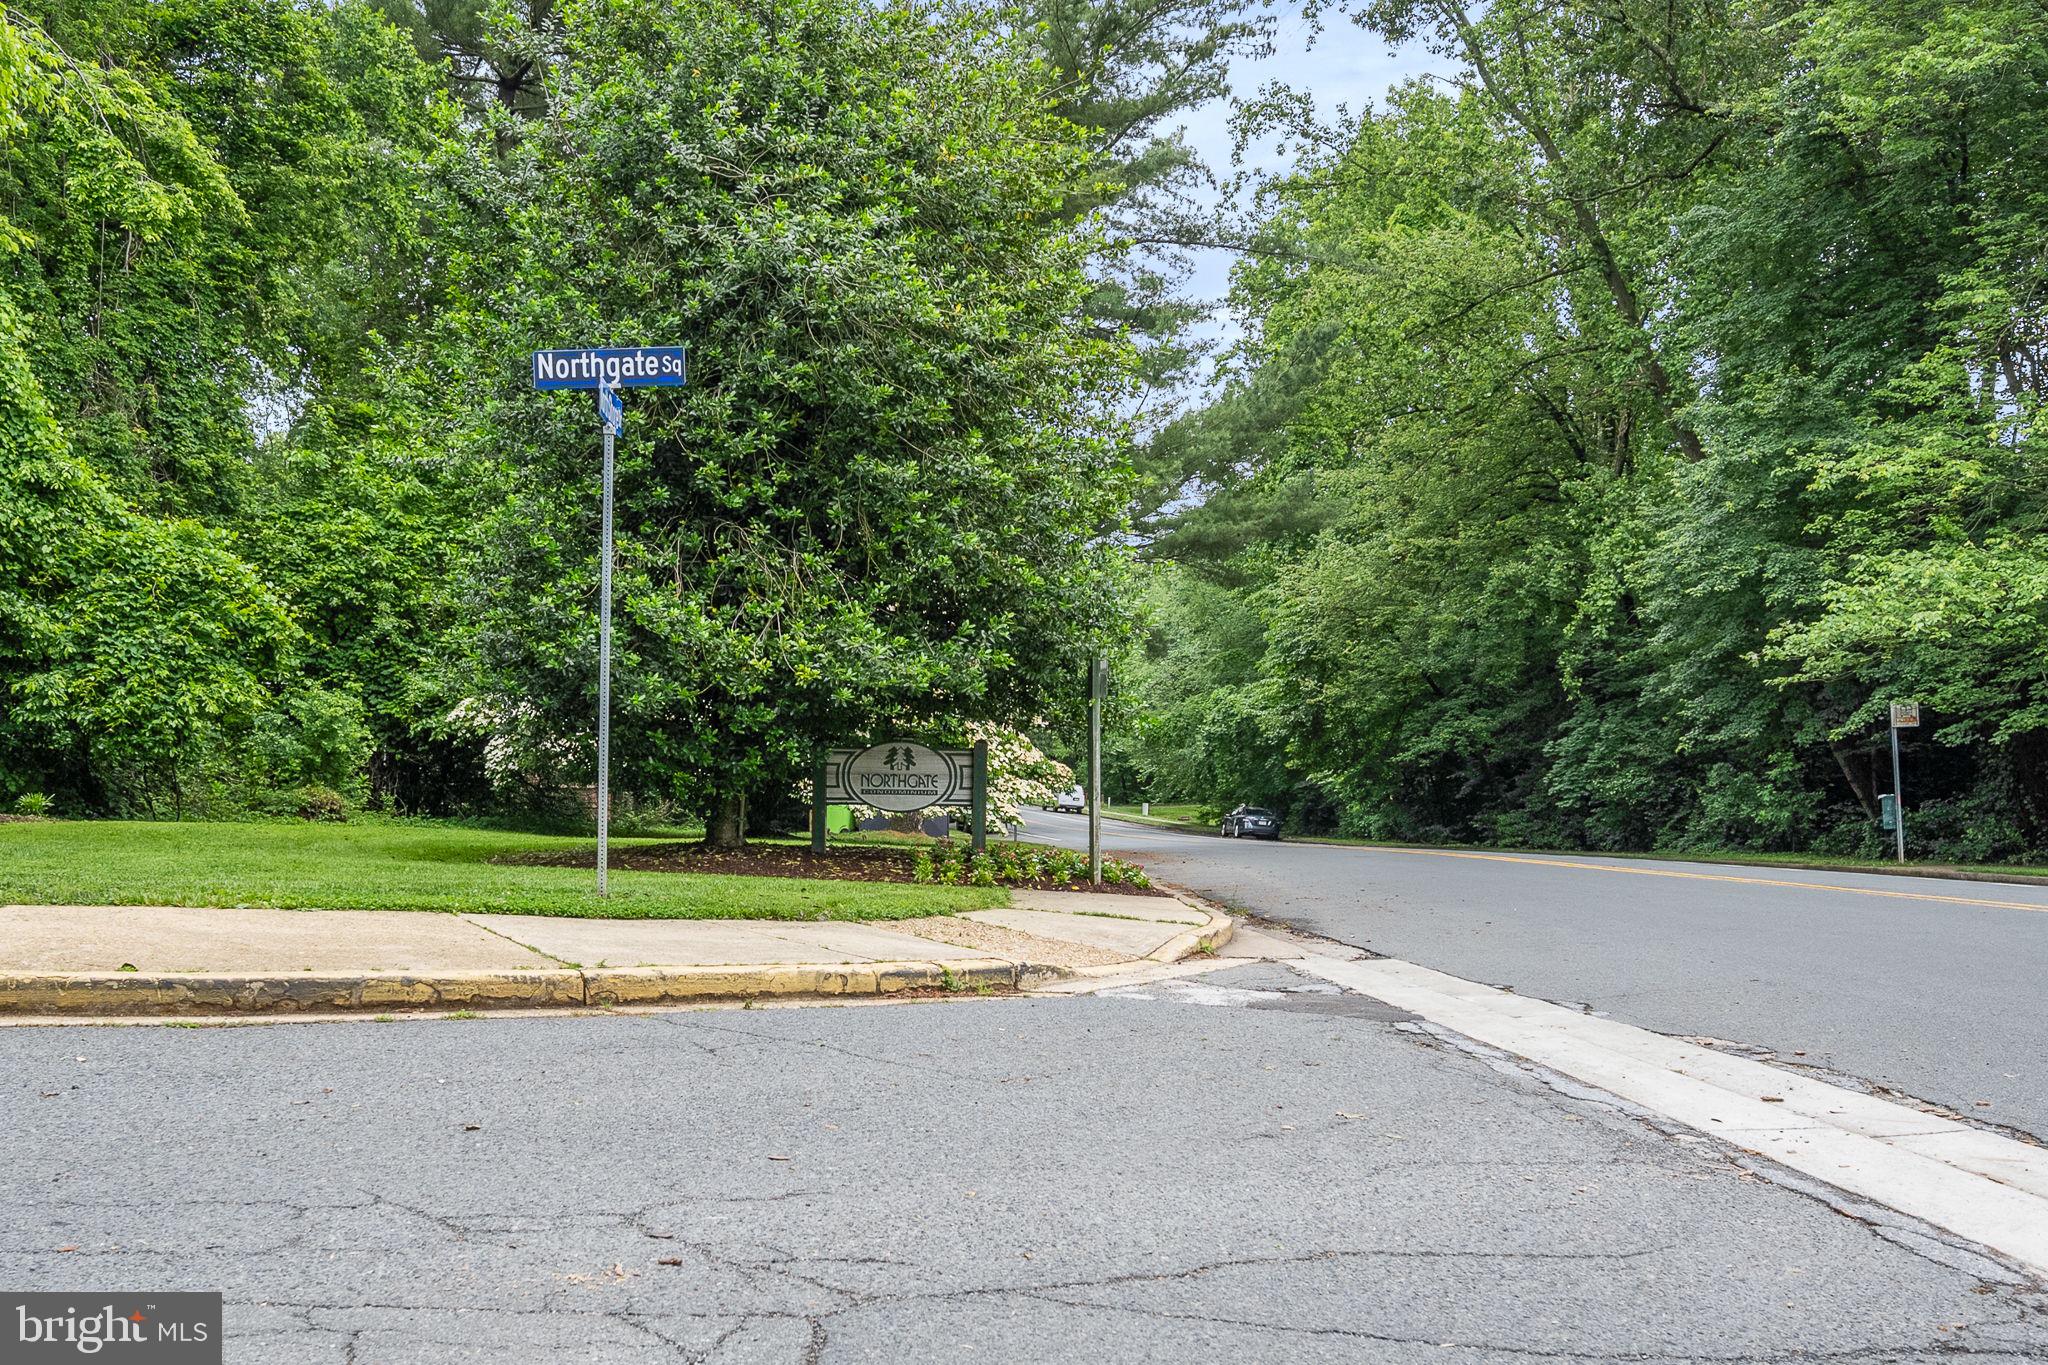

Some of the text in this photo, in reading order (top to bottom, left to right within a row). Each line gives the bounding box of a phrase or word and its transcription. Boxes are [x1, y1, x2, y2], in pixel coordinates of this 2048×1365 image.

[537, 350, 682, 384] Northgate Sq
[861, 773, 938, 788] NORTHGATE
